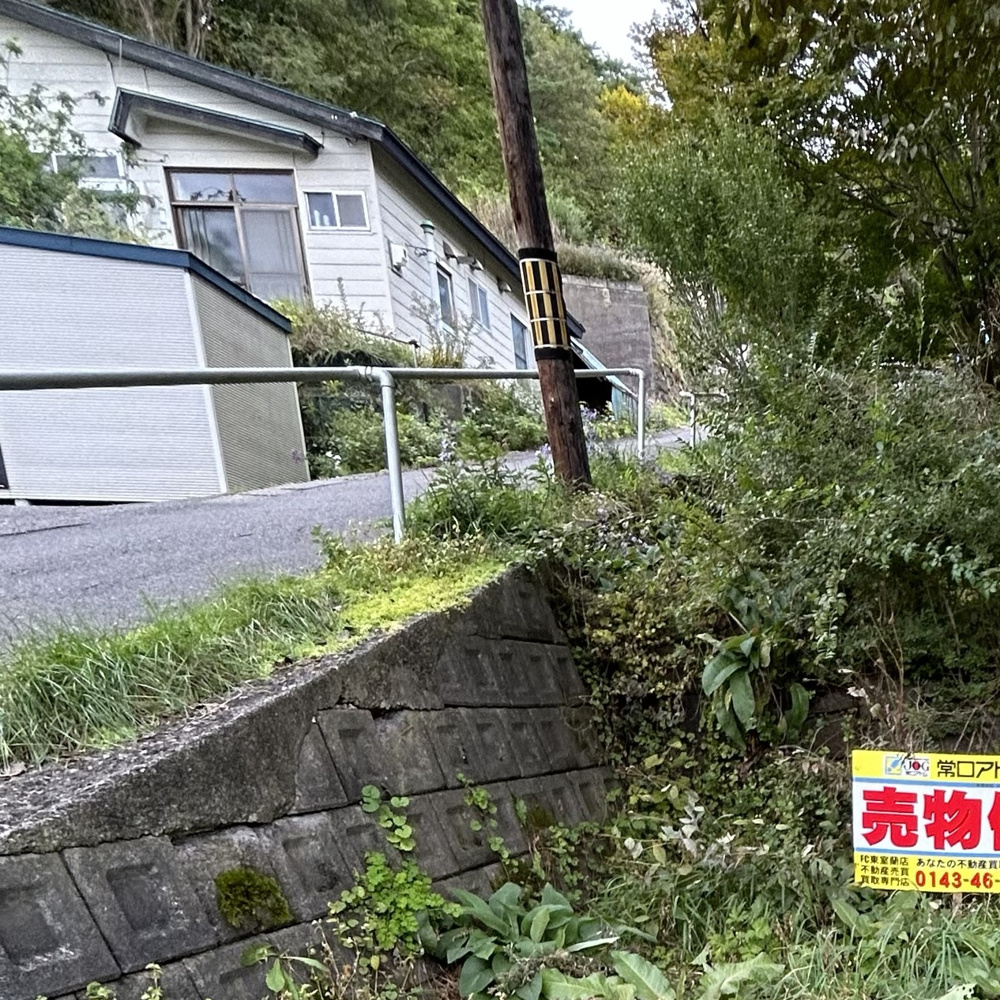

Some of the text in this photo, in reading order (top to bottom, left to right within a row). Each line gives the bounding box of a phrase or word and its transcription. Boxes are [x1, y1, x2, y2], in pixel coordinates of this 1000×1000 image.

[860, 854, 909, 866] FC東室蘭店
[860, 865, 909, 876] 不動産売買
[860, 875, 909, 886] 買取専門店
